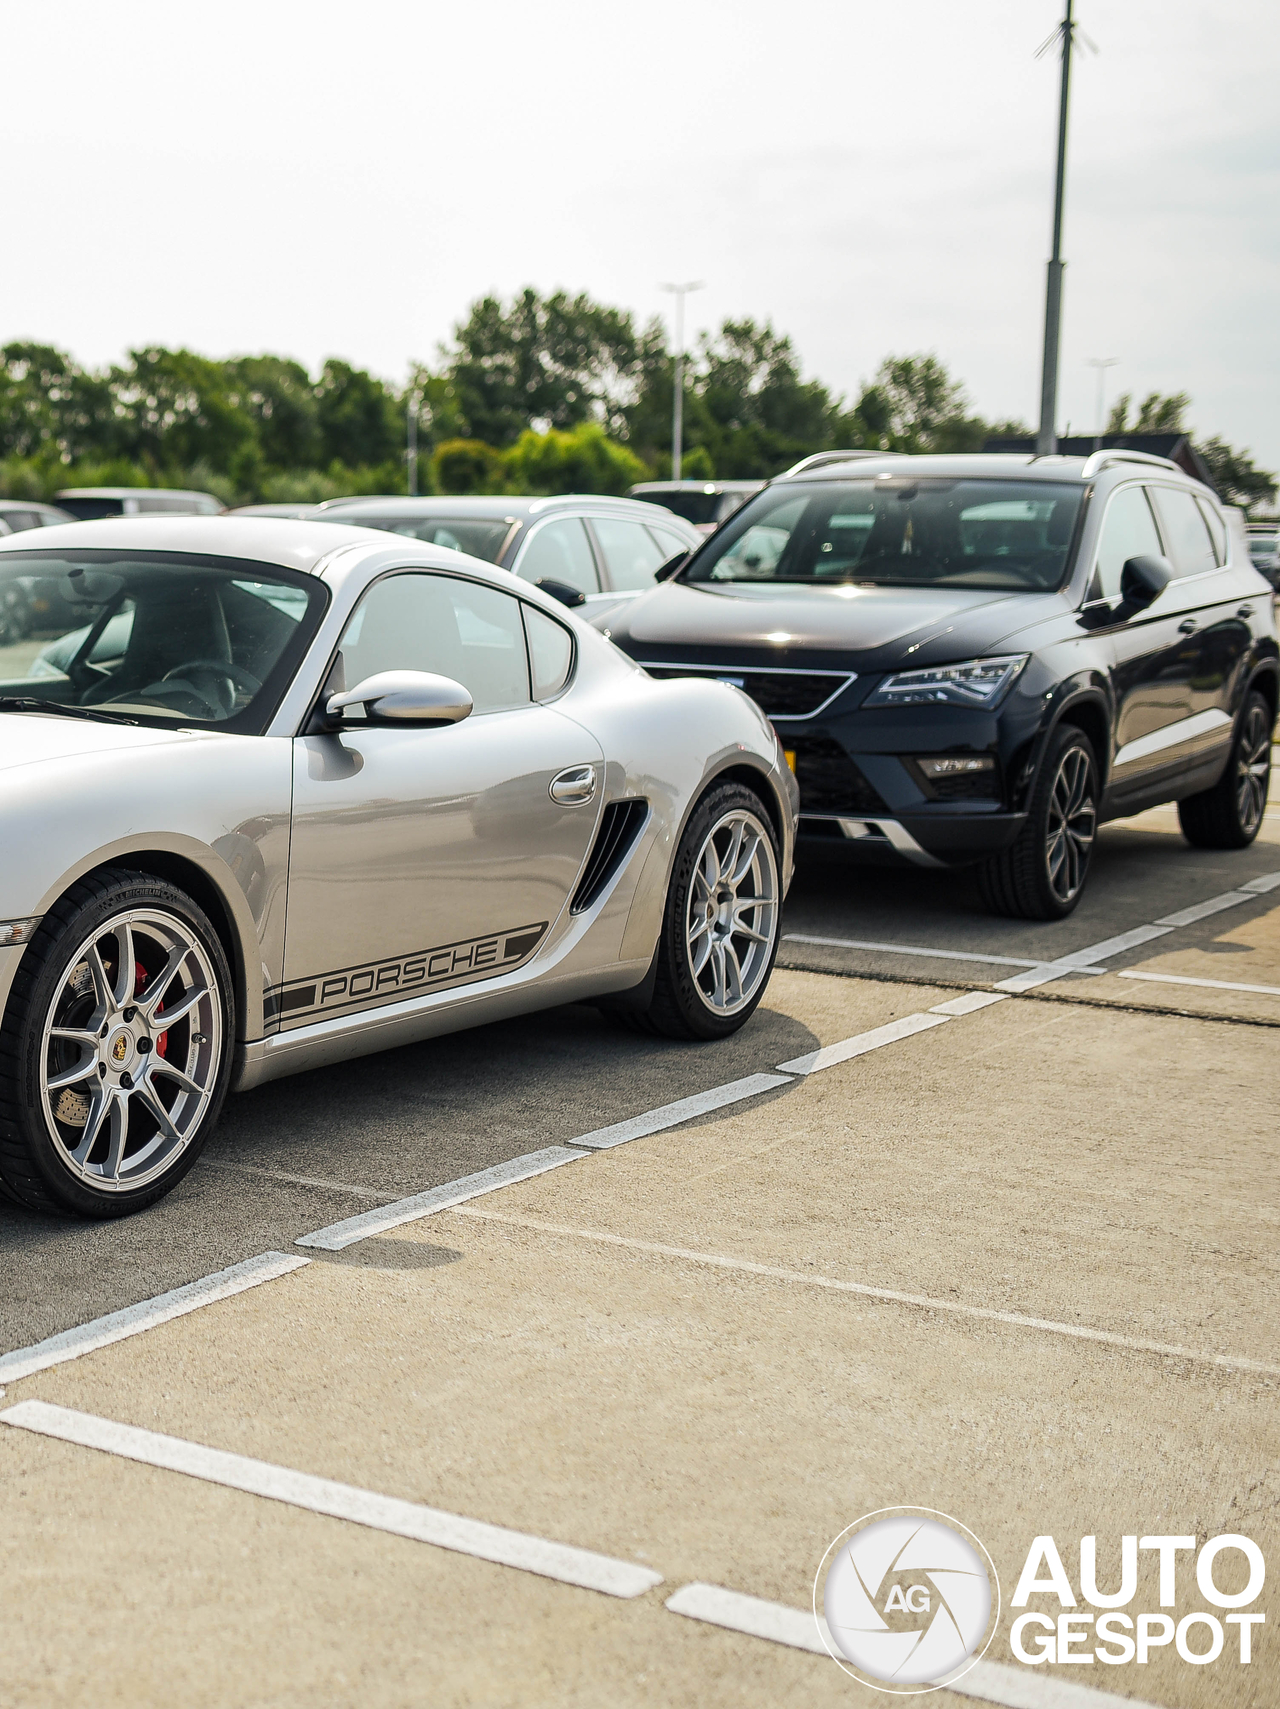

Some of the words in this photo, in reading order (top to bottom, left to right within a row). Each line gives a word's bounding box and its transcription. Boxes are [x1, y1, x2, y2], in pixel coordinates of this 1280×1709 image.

[125, 888, 161, 898] MICHELIN
[674, 886, 684, 963] MICHELIN
[320, 939, 499, 1005] PORSCHE
